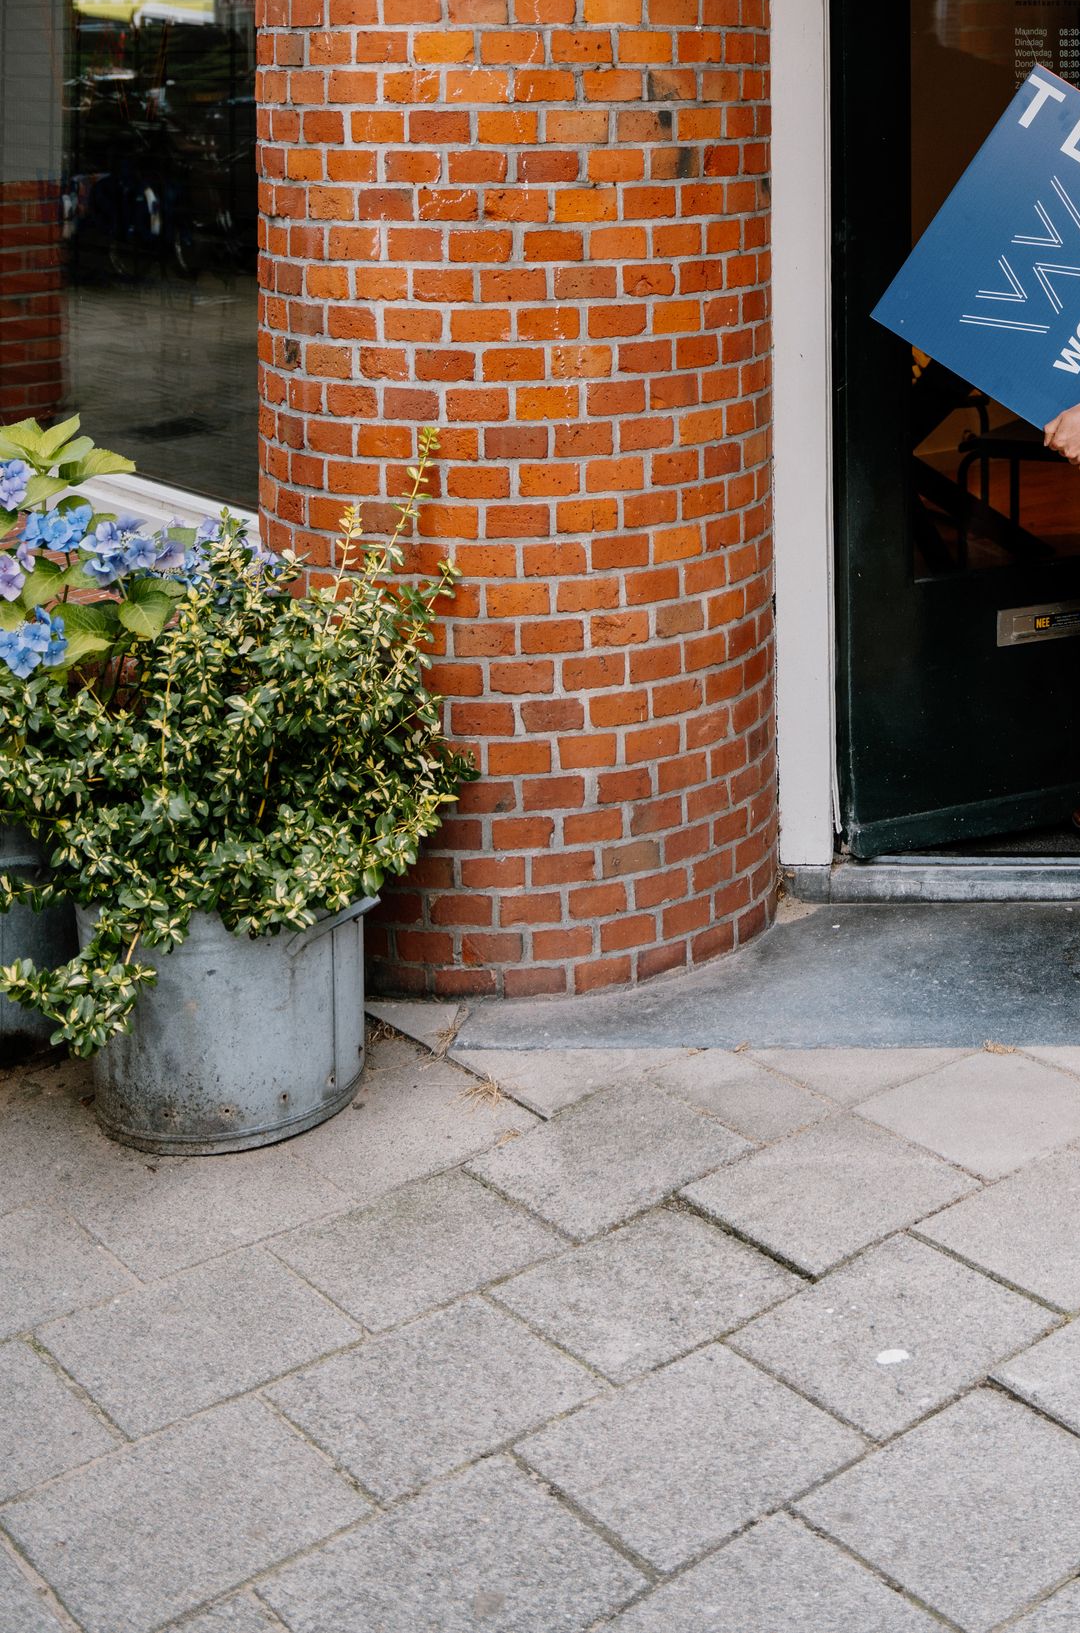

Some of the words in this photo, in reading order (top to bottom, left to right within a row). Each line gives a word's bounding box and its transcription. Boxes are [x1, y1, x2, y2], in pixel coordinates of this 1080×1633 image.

[1015, 28, 1047, 36] Maandag
[1015, 39, 1043, 47] Dinsdag
[1036, 617, 1050, 628] NEE
